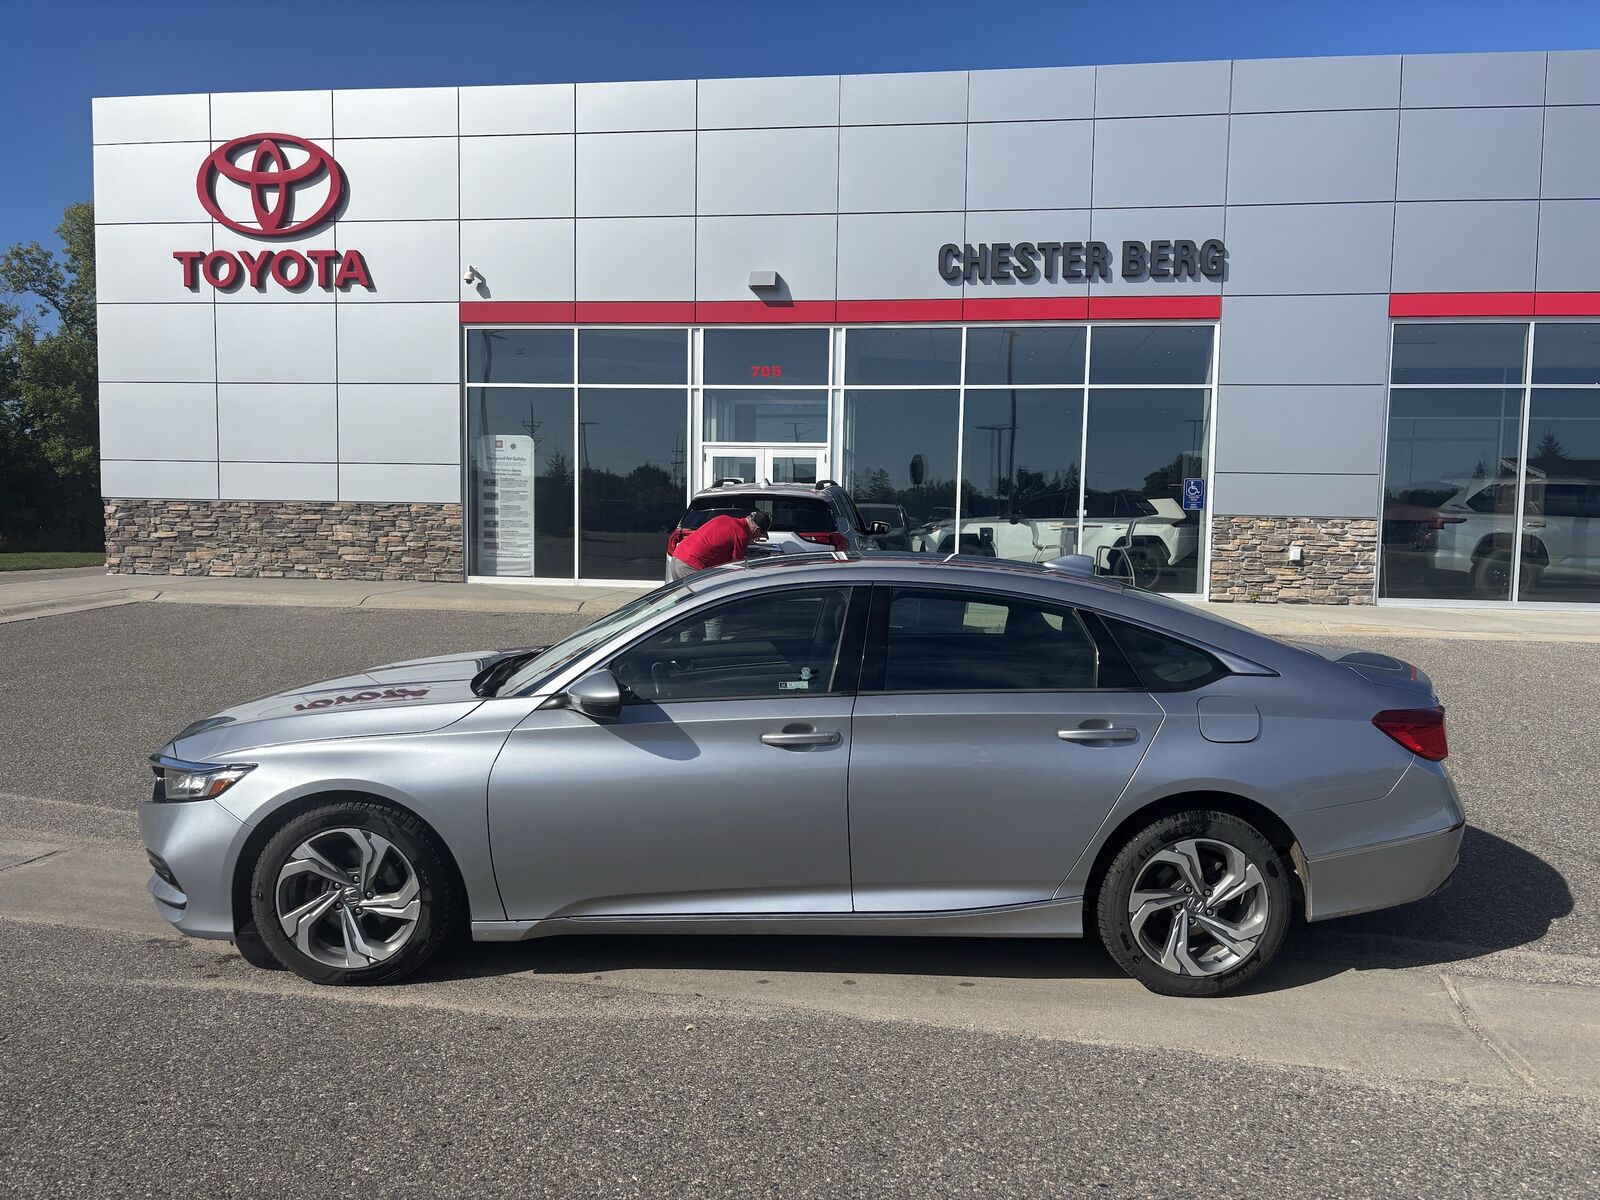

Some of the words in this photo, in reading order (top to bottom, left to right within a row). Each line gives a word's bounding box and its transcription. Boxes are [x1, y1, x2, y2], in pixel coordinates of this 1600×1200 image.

[173, 249, 371, 289] TOYOTA
[938, 240, 1110, 281] CHESTER
[1121, 239, 1226, 278] BERG
[751, 365, 781, 377] 705
